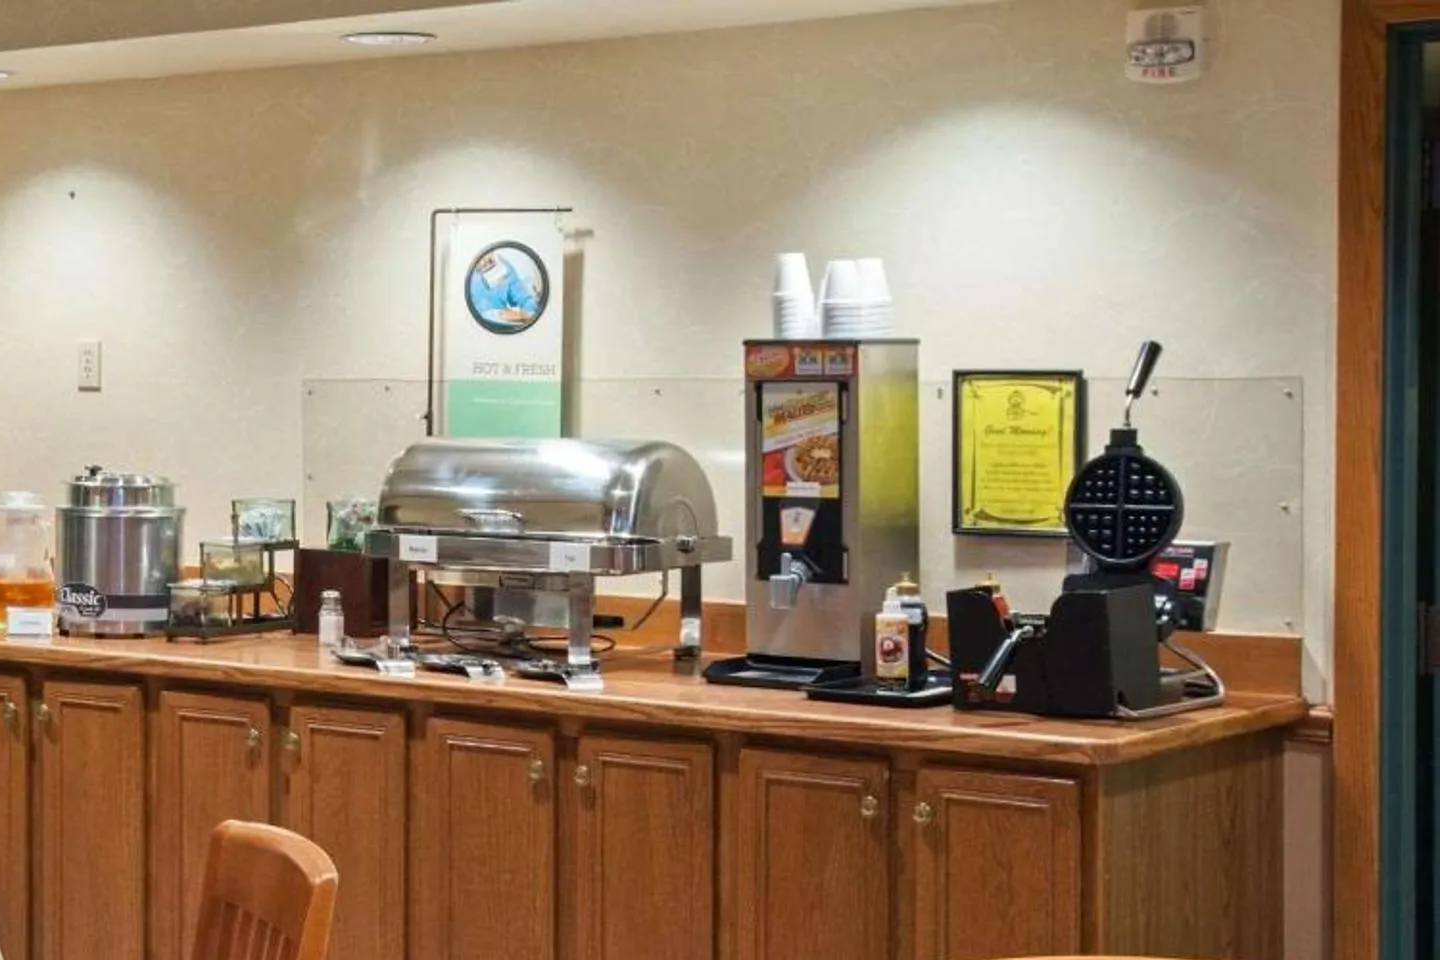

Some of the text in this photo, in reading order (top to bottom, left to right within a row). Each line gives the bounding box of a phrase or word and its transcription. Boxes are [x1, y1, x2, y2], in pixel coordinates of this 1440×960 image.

[472, 362, 499, 374] HOT
[515, 363, 556, 376] FRESH
[60, 587, 101, 605] Classic
